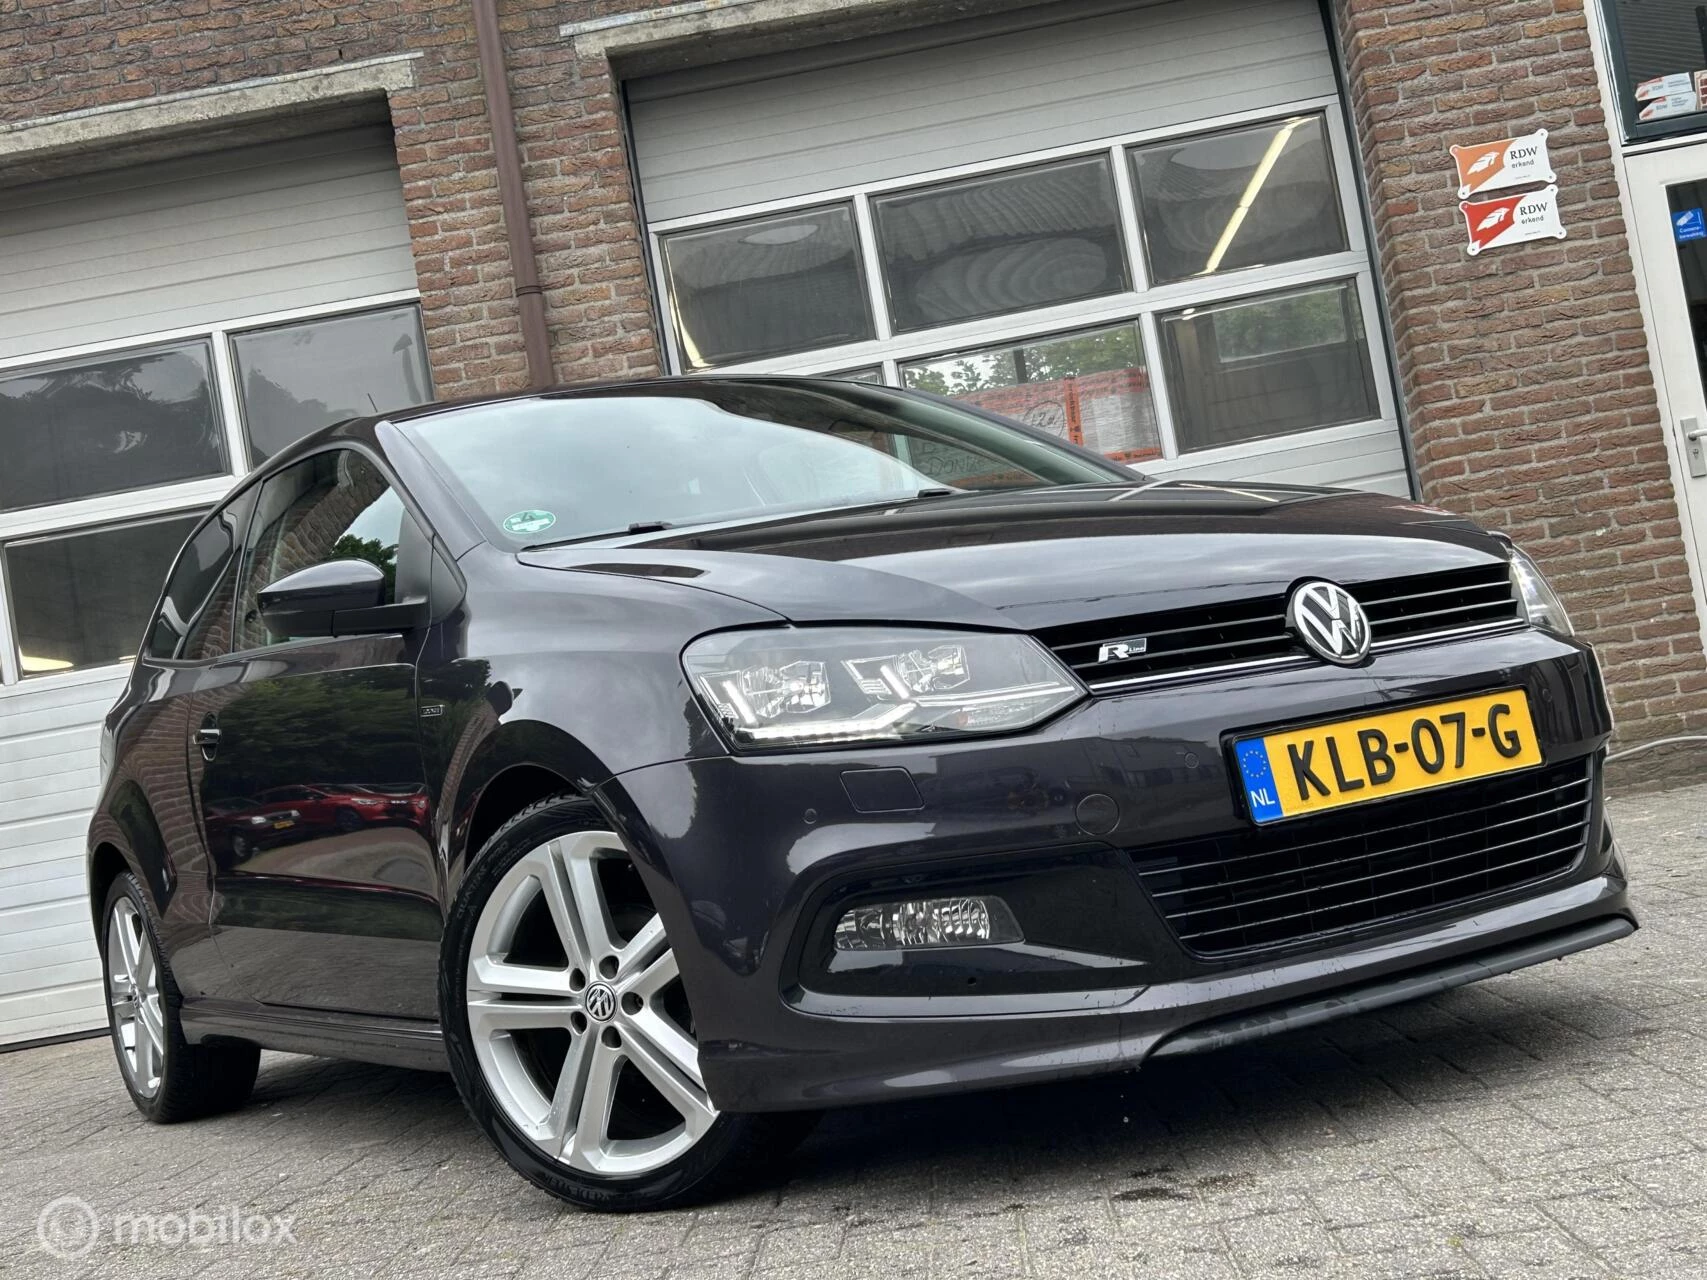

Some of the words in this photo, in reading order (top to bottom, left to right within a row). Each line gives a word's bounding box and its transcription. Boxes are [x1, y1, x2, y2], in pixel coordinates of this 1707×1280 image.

[1509, 146, 1538, 160] RDW
[1511, 158, 1535, 169] erkend
[1519, 202, 1548, 216] RDW
[1521, 215, 1545, 225] erkend
[1098, 644, 1129, 663] R
[1287, 703, 1522, 801] KLB-07-G
[1251, 788, 1275, 808] NL
